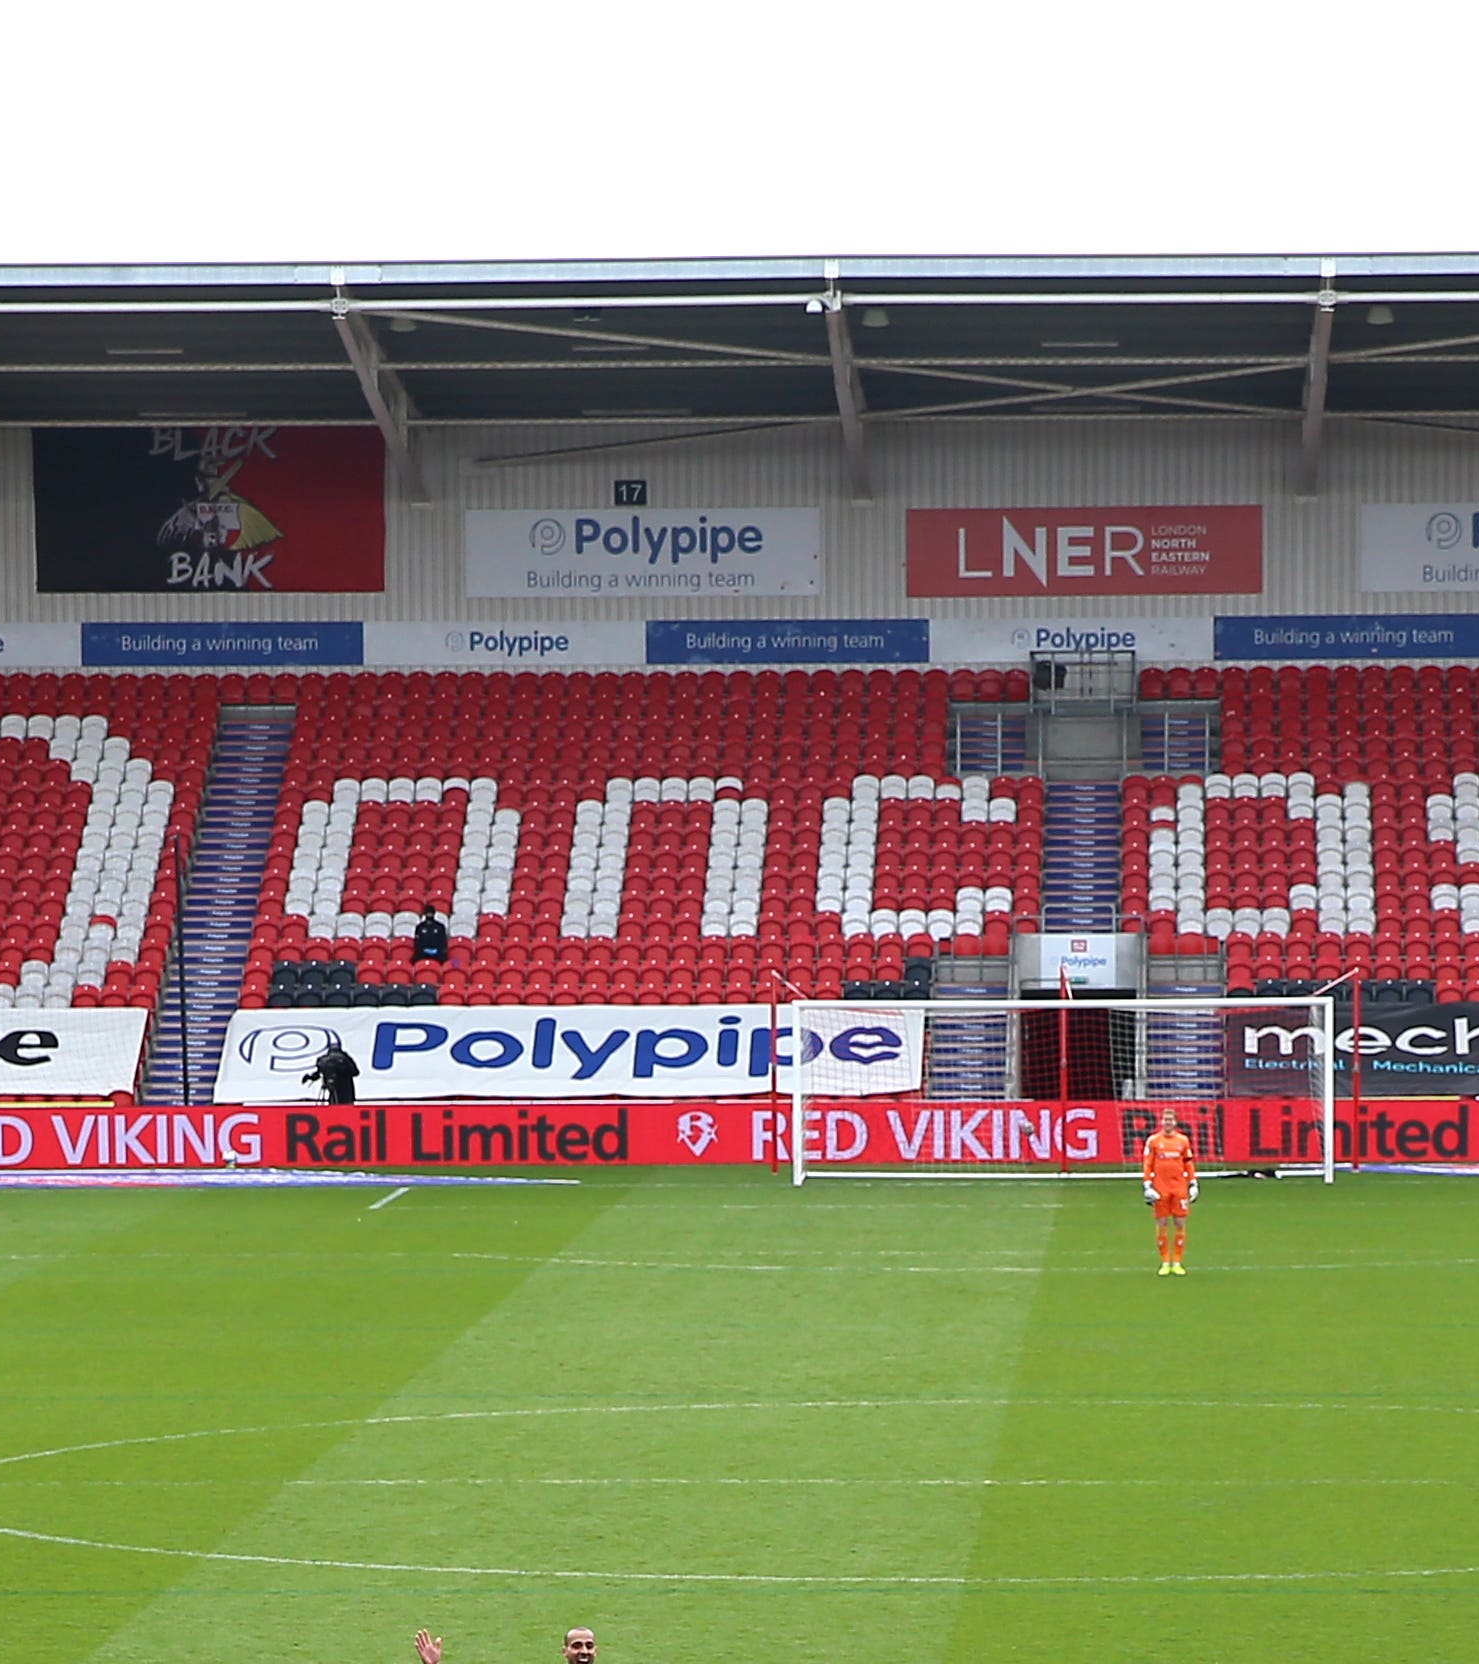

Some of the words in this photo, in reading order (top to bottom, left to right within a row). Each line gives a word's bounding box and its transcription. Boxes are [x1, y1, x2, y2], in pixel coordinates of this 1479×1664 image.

[149, 427, 277, 459] BLACK
[619, 485, 644, 503] 17
[574, 516, 763, 565] Polypipe
[1150, 524, 1208, 537] LONDON
[957, 515, 1146, 588] LNER
[1150, 538, 1196, 550] NORTH
[166, 550, 274, 589] BANK
[1150, 551, 1210, 564] EASTERN
[526, 570, 603, 593] Building
[607, 574, 619, 589] a
[624, 571, 702, 593] winning
[707, 571, 755, 589] team
[121, 634, 186, 656] Building
[207, 635, 273, 656] winning
[278, 635, 319, 651] team
[469, 630, 570, 657] Polypipe
[686, 632, 752, 653] Building
[771, 633, 838, 653] winning
[842, 633, 885, 649] team
[1036, 627, 1136, 653] Polypipe
[1253, 628, 1320, 649] Building
[1341, 627, 1407, 648] winning
[1412, 626, 1456, 645] team
[370, 1015, 904, 1080] Polypipe
[51, 1112, 262, 1166] VIKING
[285, 1112, 387, 1164] Rail
[420, 1110, 629, 1163] Limited
[885, 1108, 1099, 1161] VIKING
